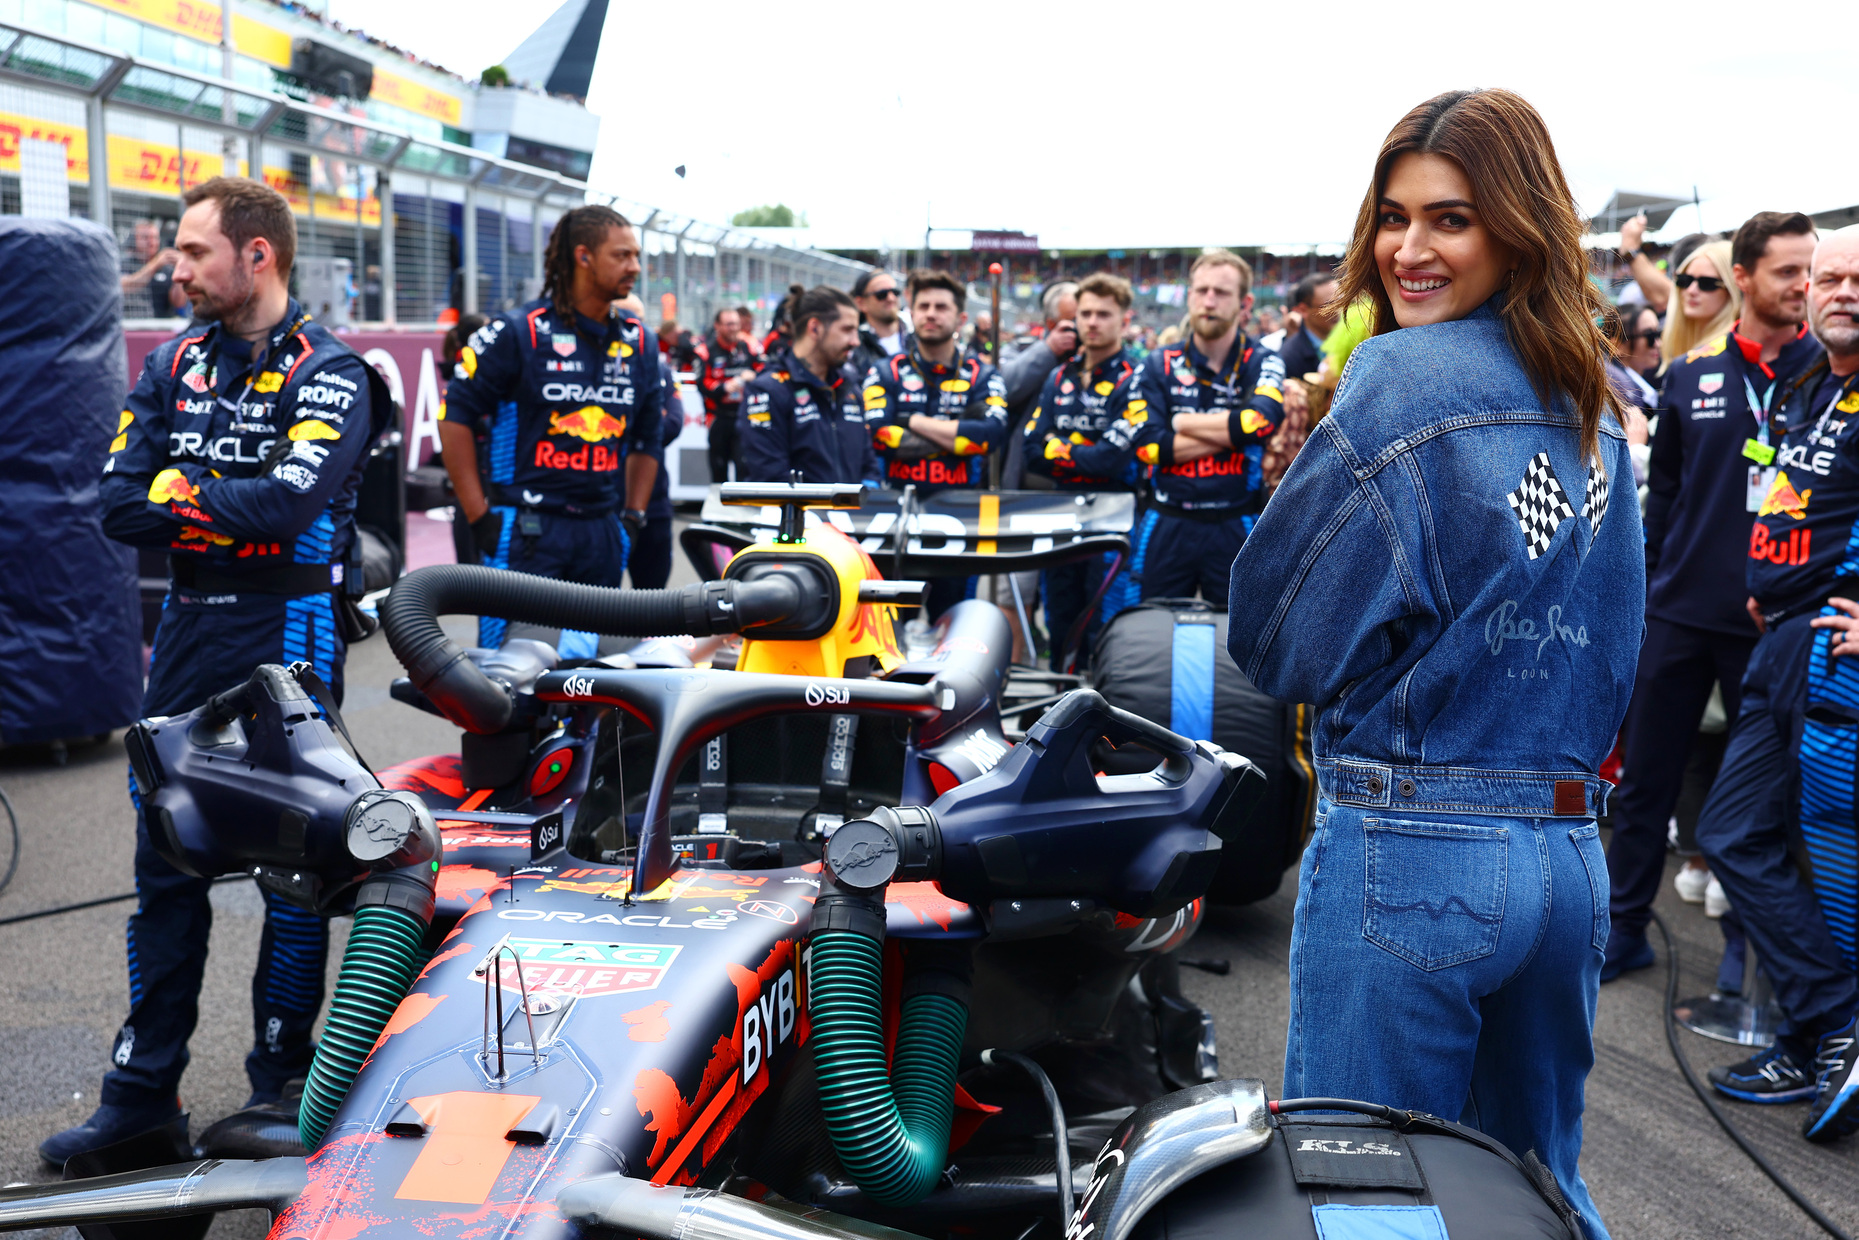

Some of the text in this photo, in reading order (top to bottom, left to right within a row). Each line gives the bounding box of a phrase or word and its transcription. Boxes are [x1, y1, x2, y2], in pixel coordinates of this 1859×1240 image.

[297, 385, 354, 410] ROKT
[542, 383, 635, 405] ORACLE
[176, 398, 203, 414] obil
[229, 421, 277, 433] HNDA
[169, 432, 277, 463] ORACLE
[534, 440, 590, 471] Red
[888, 459, 968, 484] Red Bull
[1198, 453, 1245, 478] Bull
[1749, 521, 1812, 566] Bull
[576, 678, 595, 697] Sui
[825, 686, 850, 704] Sui
[831, 717, 851, 771] sparco
[547, 822, 559, 843] Sui
[705, 842, 718, 859] 1
[497, 909, 728, 931] ORACLE
[510, 943, 662, 964] TAG
[489, 964, 653, 990] HEUER
